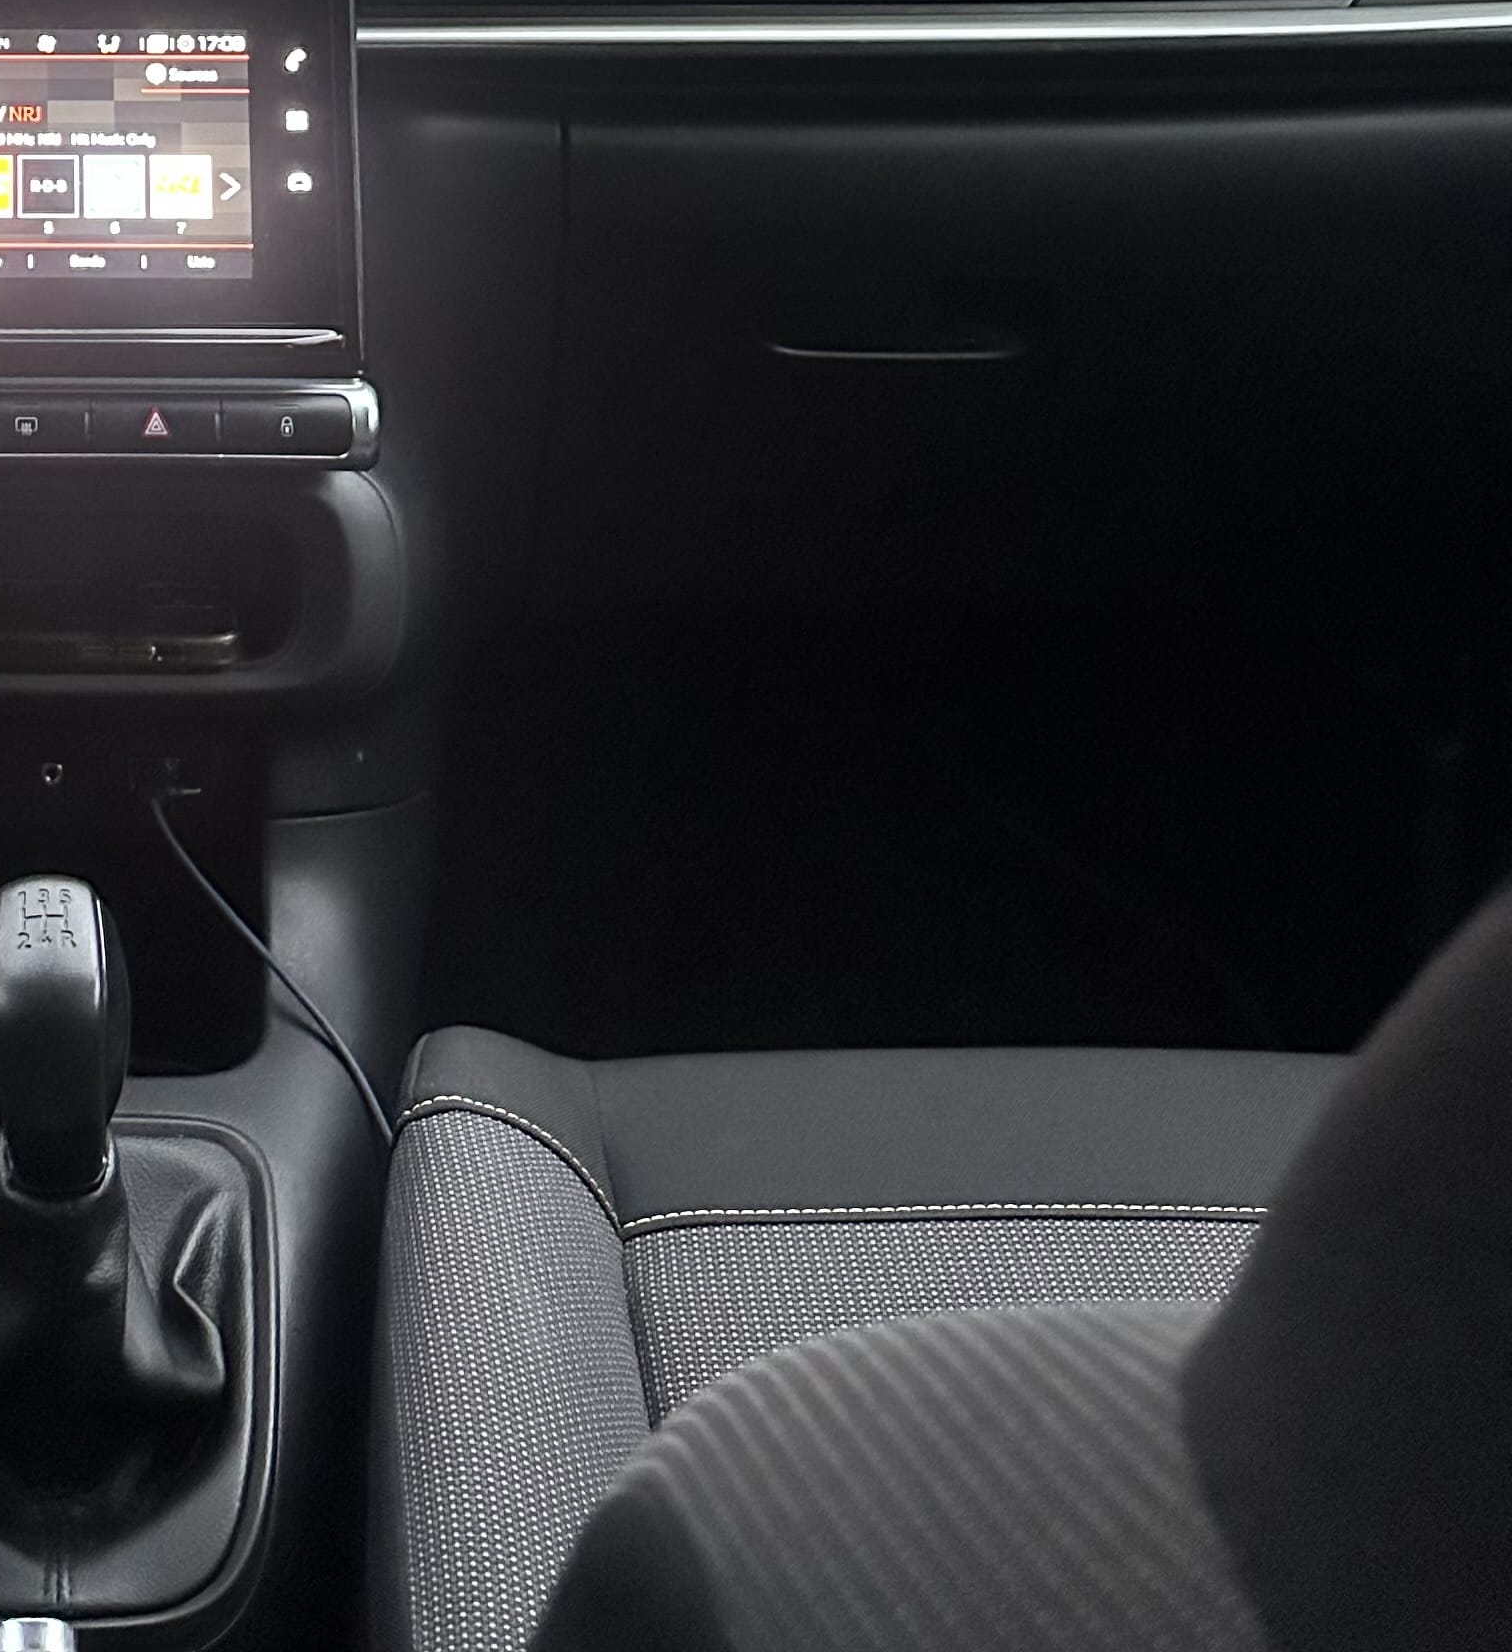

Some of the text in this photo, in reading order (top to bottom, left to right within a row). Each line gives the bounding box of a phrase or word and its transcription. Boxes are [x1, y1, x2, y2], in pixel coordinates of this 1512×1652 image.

[8, 105, 43, 123] NRJ
[17, 890, 27, 906] 1
[17, 931, 32, 950] 2
[61, 929, 77, 948] R
